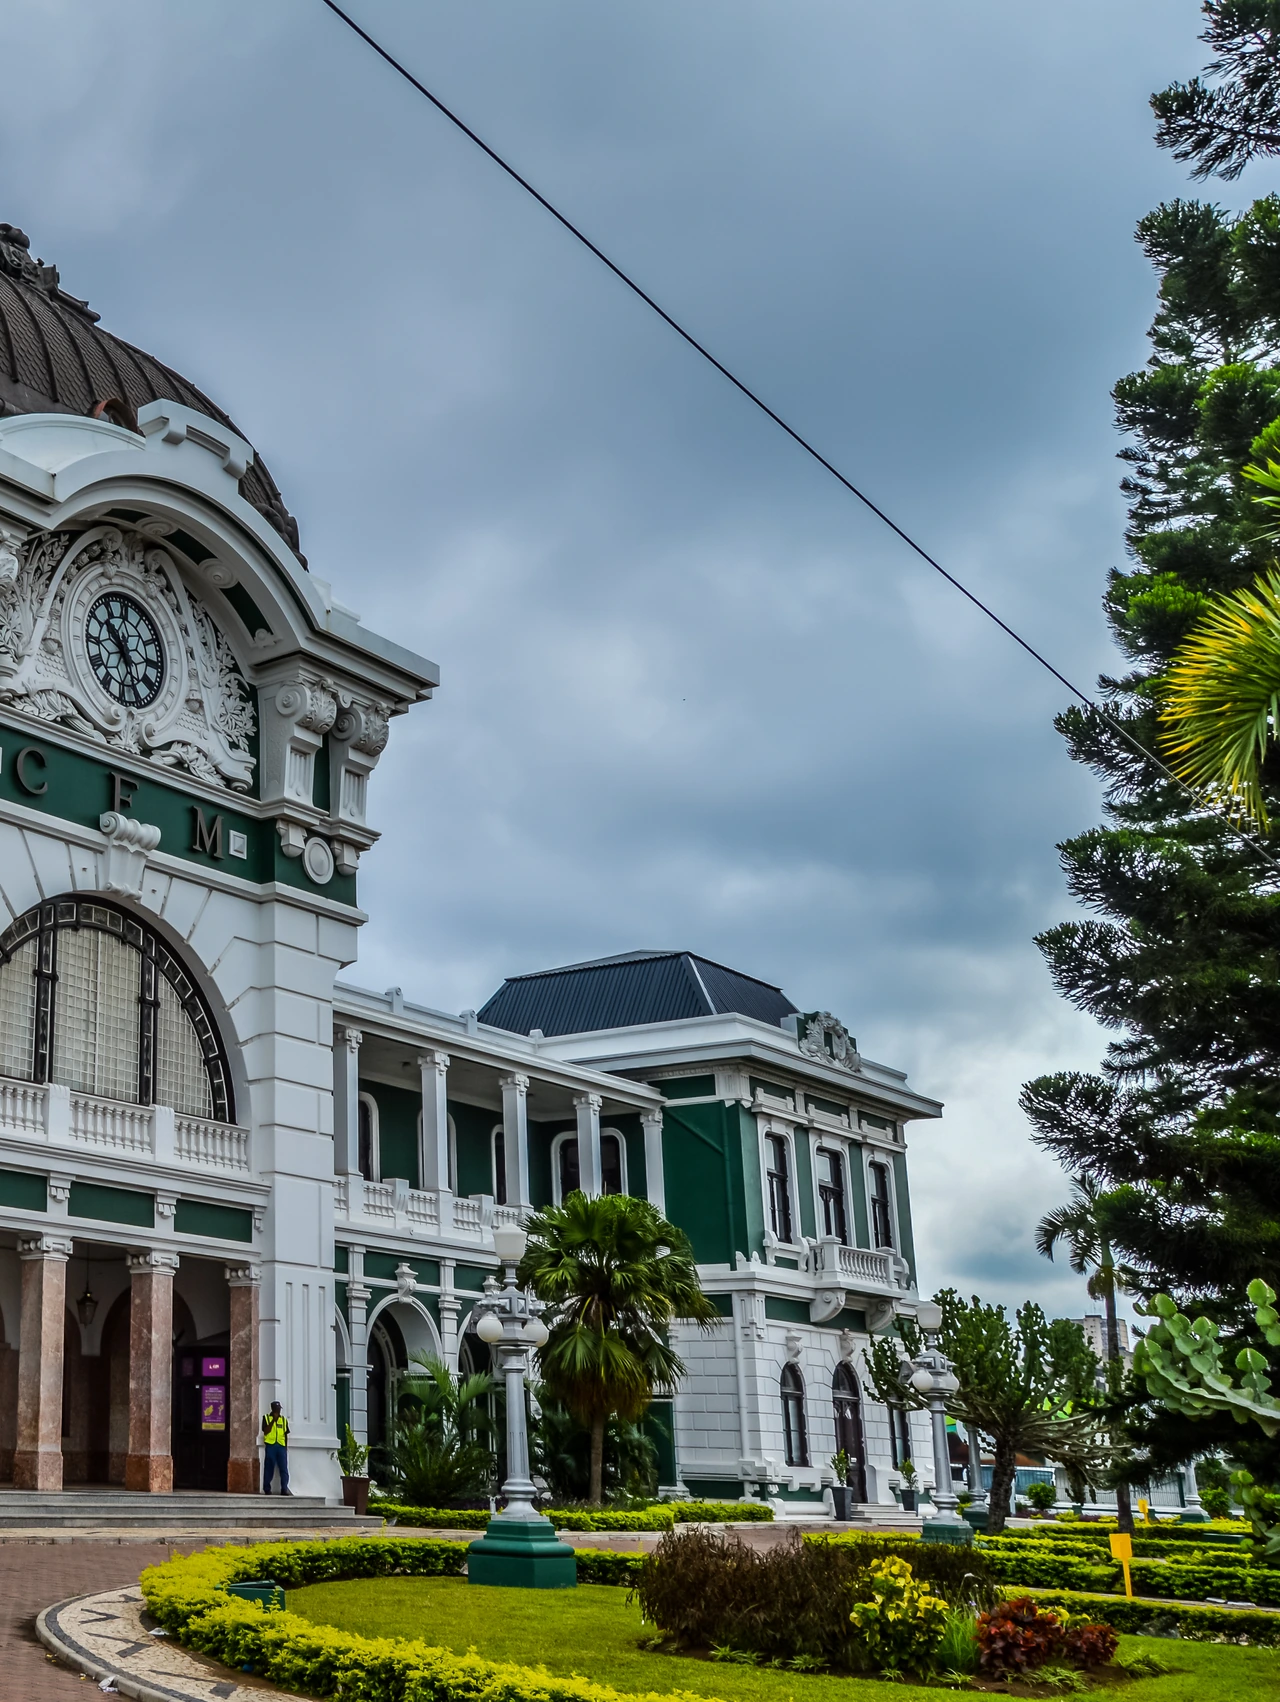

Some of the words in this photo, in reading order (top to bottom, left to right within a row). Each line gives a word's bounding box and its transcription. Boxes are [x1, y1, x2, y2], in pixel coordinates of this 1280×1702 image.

[16, 747, 48, 795] C
[111, 773, 139, 813] F
[192, 805, 225, 860] M
